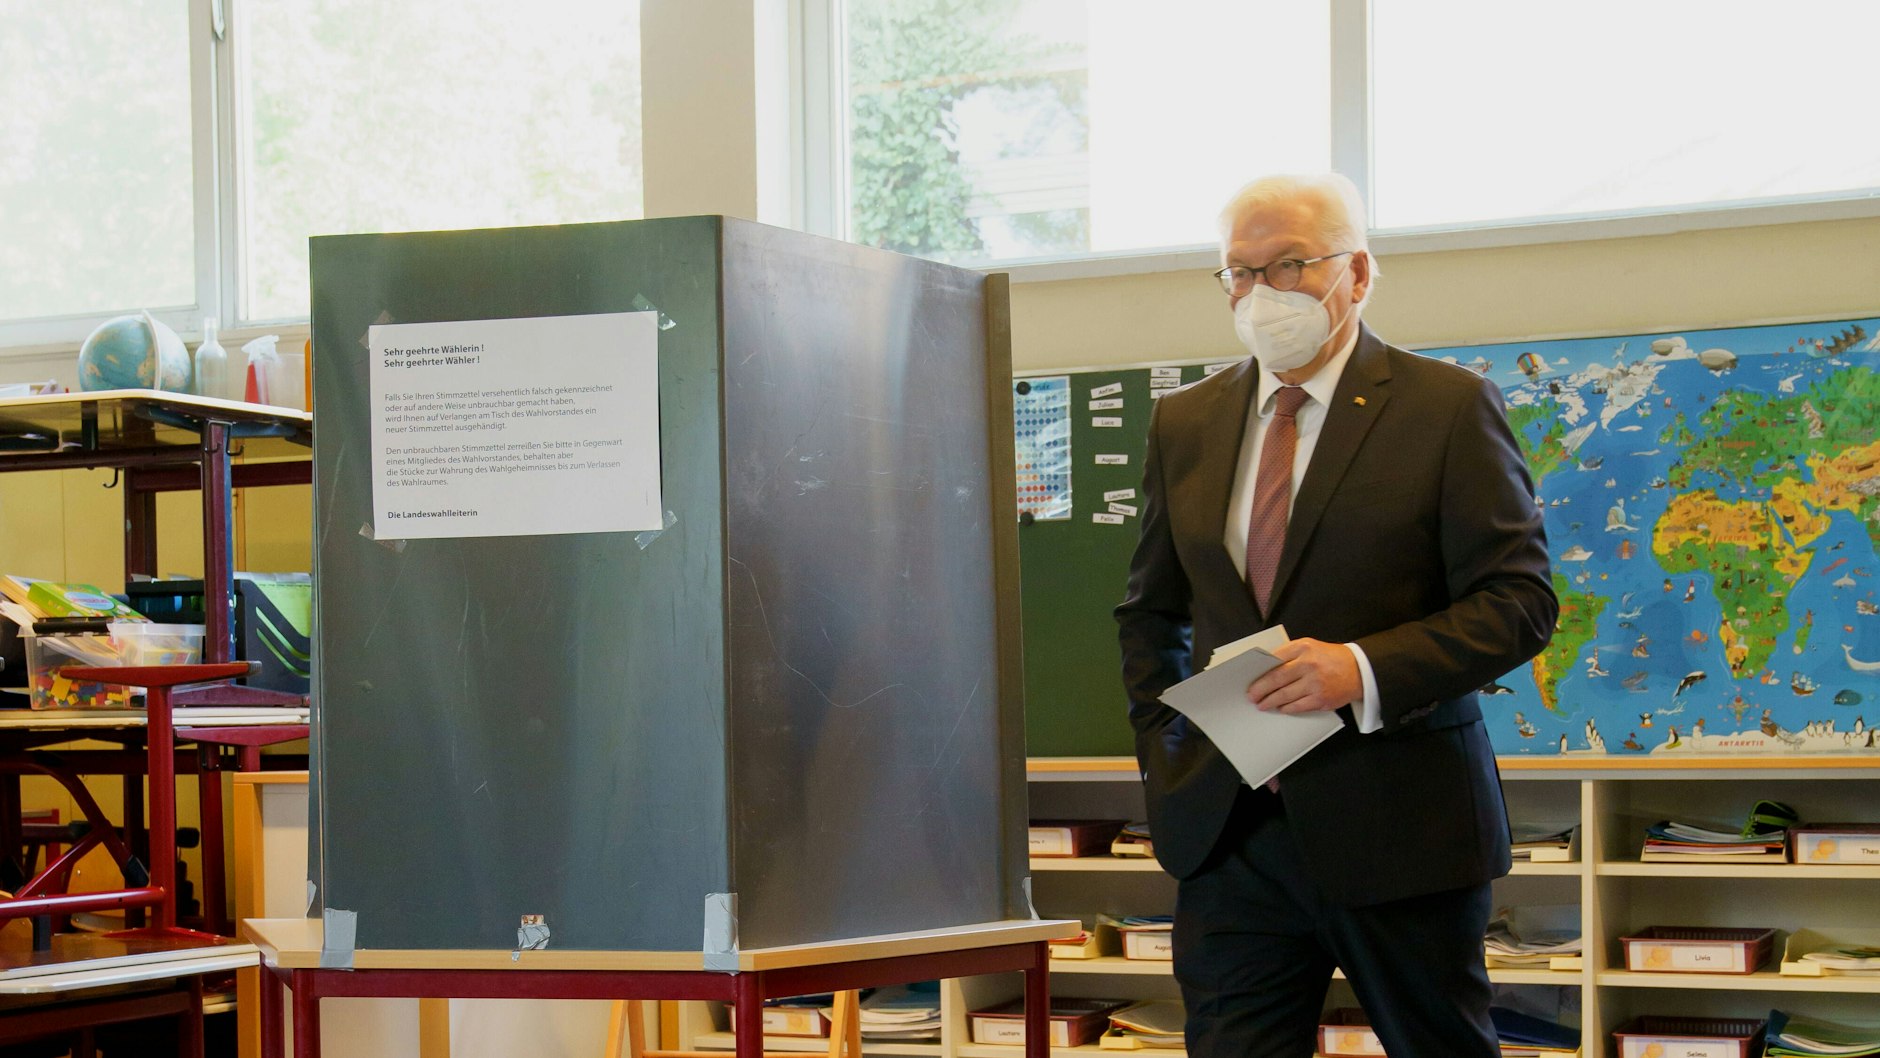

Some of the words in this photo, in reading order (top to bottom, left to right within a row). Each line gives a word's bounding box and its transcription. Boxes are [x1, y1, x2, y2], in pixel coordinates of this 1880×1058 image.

[384, 347, 405, 356] Sehr
[405, 346, 440, 357] geehrte
[440, 344, 480, 354] Wählerin
[384, 359, 405, 367] Sehr
[405, 357, 444, 368] geehrter
[444, 356, 476, 365] Wähler
[384, 392, 401, 401] Falls
[402, 391, 414, 400] Sie
[414, 391, 435, 399] Ihren
[436, 389, 480, 399] Stimmzettel
[481, 387, 531, 397] versehentlich
[532, 386, 554, 395] falsch
[554, 384, 613, 396] gekennzeichnet
[385, 403, 403, 412] oder
[404, 403, 416, 411] auf
[417, 402, 444, 411] andere
[444, 401, 467, 409] Weise
[468, 399, 515, 409] unbrauchbar
[515, 397, 549, 408] gemacht
[385, 414, 402, 423] wird
[403, 413, 425, 422] Ihnen
[427, 413, 439, 421] auf
[439, 411, 477, 422] Verlangen
[491, 410, 510, 419] Tisch
[511, 409, 525, 418] des
[525, 407, 584, 417] Wahlvorstandes
[585, 407, 597, 415] ein
[408, 423, 454, 432] Stimmzettel
[386, 446, 402, 455] Den
[402, 444, 461, 454] unbrauchbaren
[461, 442, 506, 452] Stimmzettel
[506, 441, 542, 450] zerreißen
[542, 441, 554, 449] Sie
[555, 440, 573, 449] bitte
[574, 440, 581, 448] in
[582, 438, 623, 449] Gegenwart
[386, 457, 406, 466] eines
[407, 456, 447, 467] Mitgliedes
[448, 455, 461, 463] des
[523, 452, 556, 461] behalten
[556, 451, 574, 460] aber
[386, 468, 399, 476] die
[399, 467, 425, 476] Stücke
[439, 465, 474, 476] Wahrung
[474, 464, 488, 473] des
[489, 462, 557, 474] Wahlgeheimnisses
[557, 462, 569, 470] bis
[586, 460, 621, 469] Verlassen
[387, 479, 400, 487] des
[388, 510, 401, 519] Die
[402, 509, 478, 518] Landeswahlleiterin
